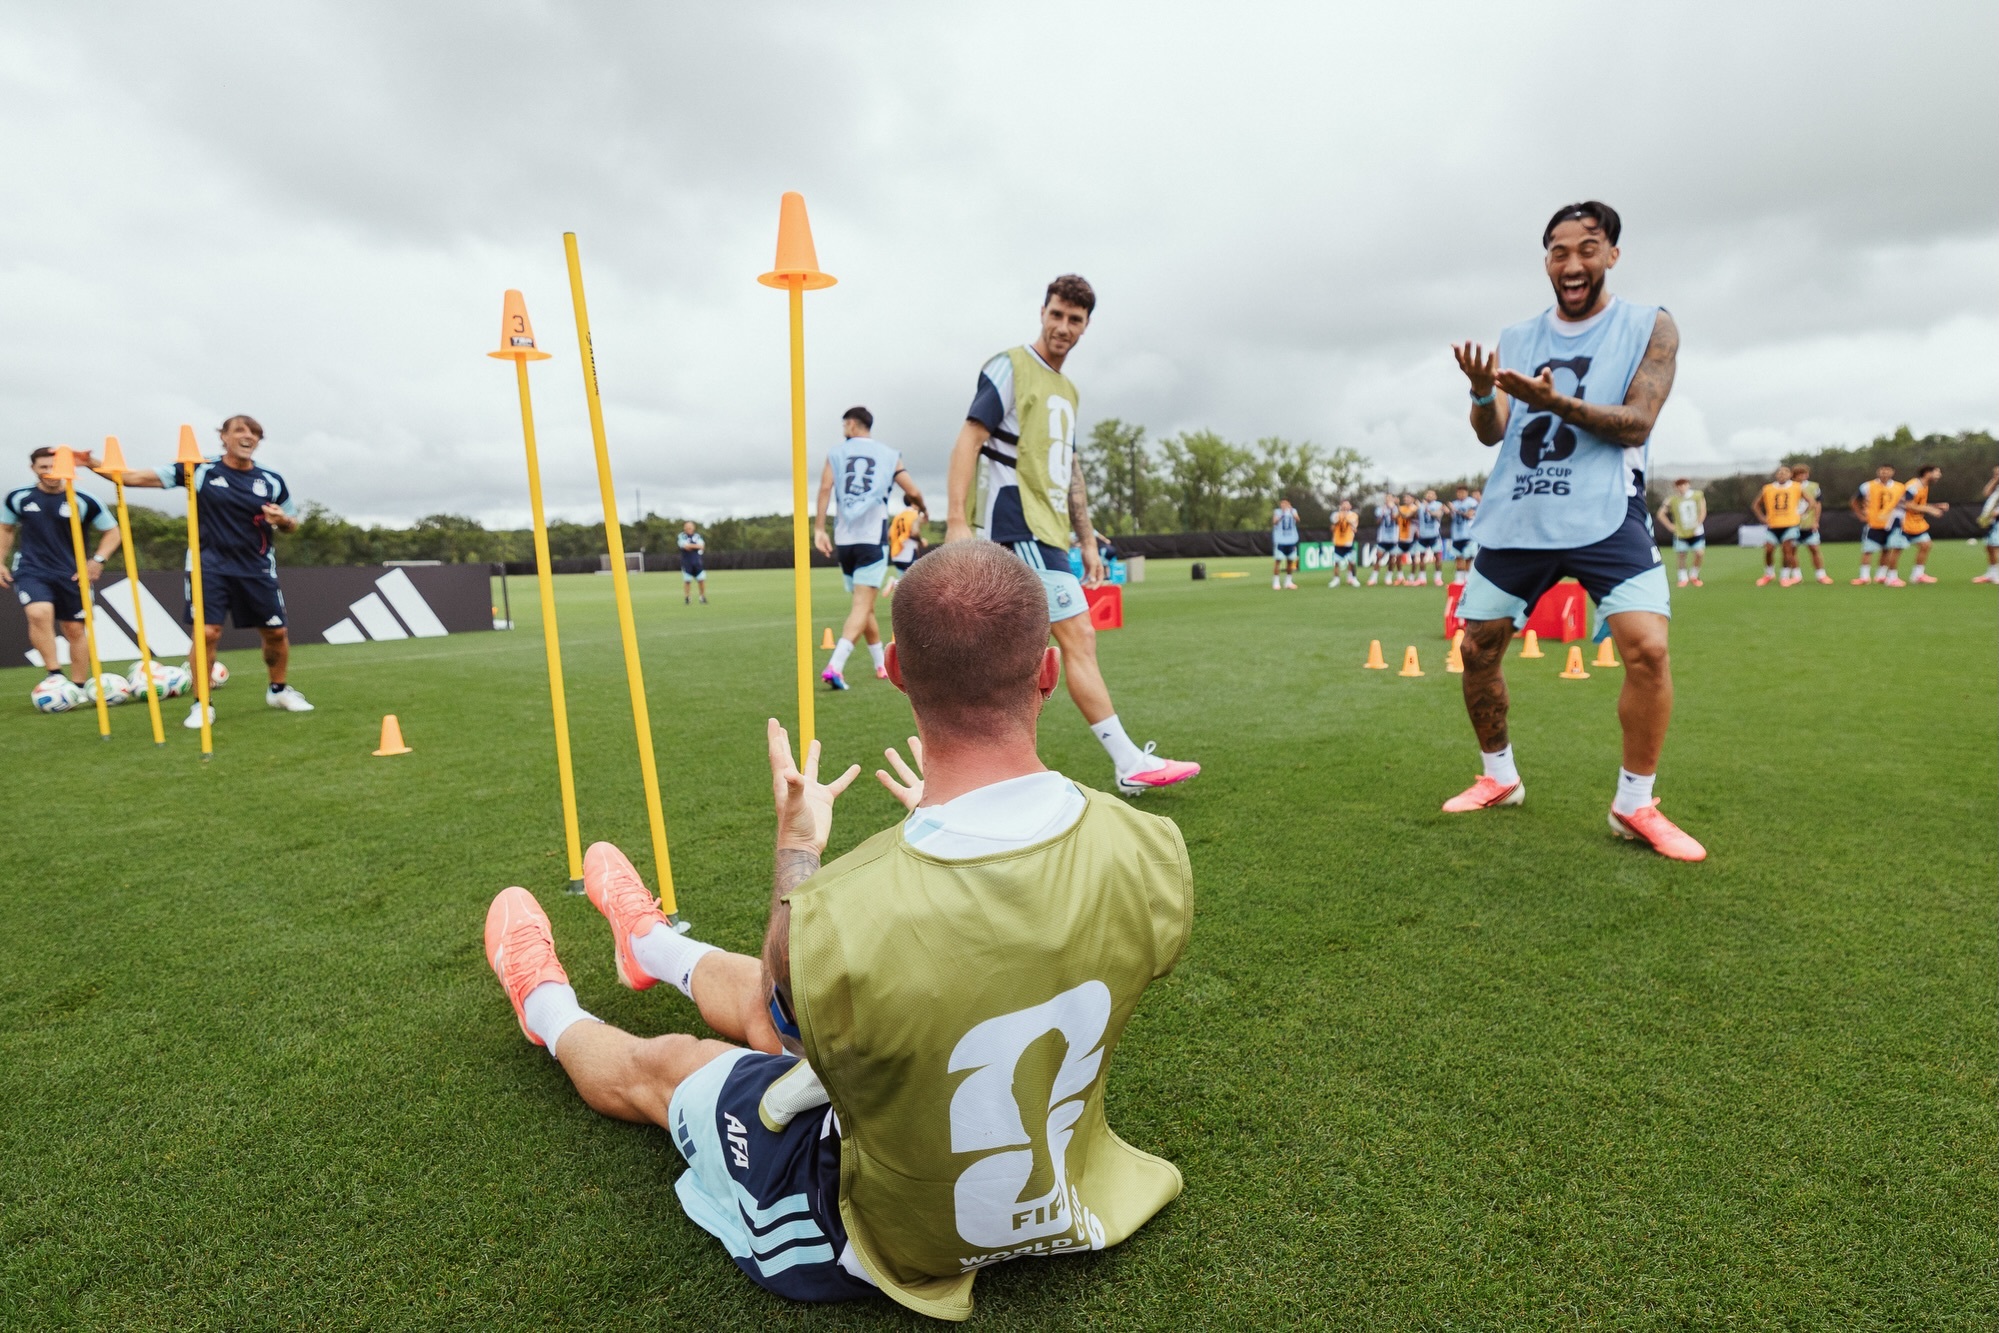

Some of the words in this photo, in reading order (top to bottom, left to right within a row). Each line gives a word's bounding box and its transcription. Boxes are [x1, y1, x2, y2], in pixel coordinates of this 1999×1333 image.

[512, 315, 525, 333] 3
[1547, 467, 1572, 477] CUP
[724, 1112, 749, 1169] AFA
[1012, 1192, 1064, 1231] FIF
[959, 1238, 1073, 1266] WORLD
